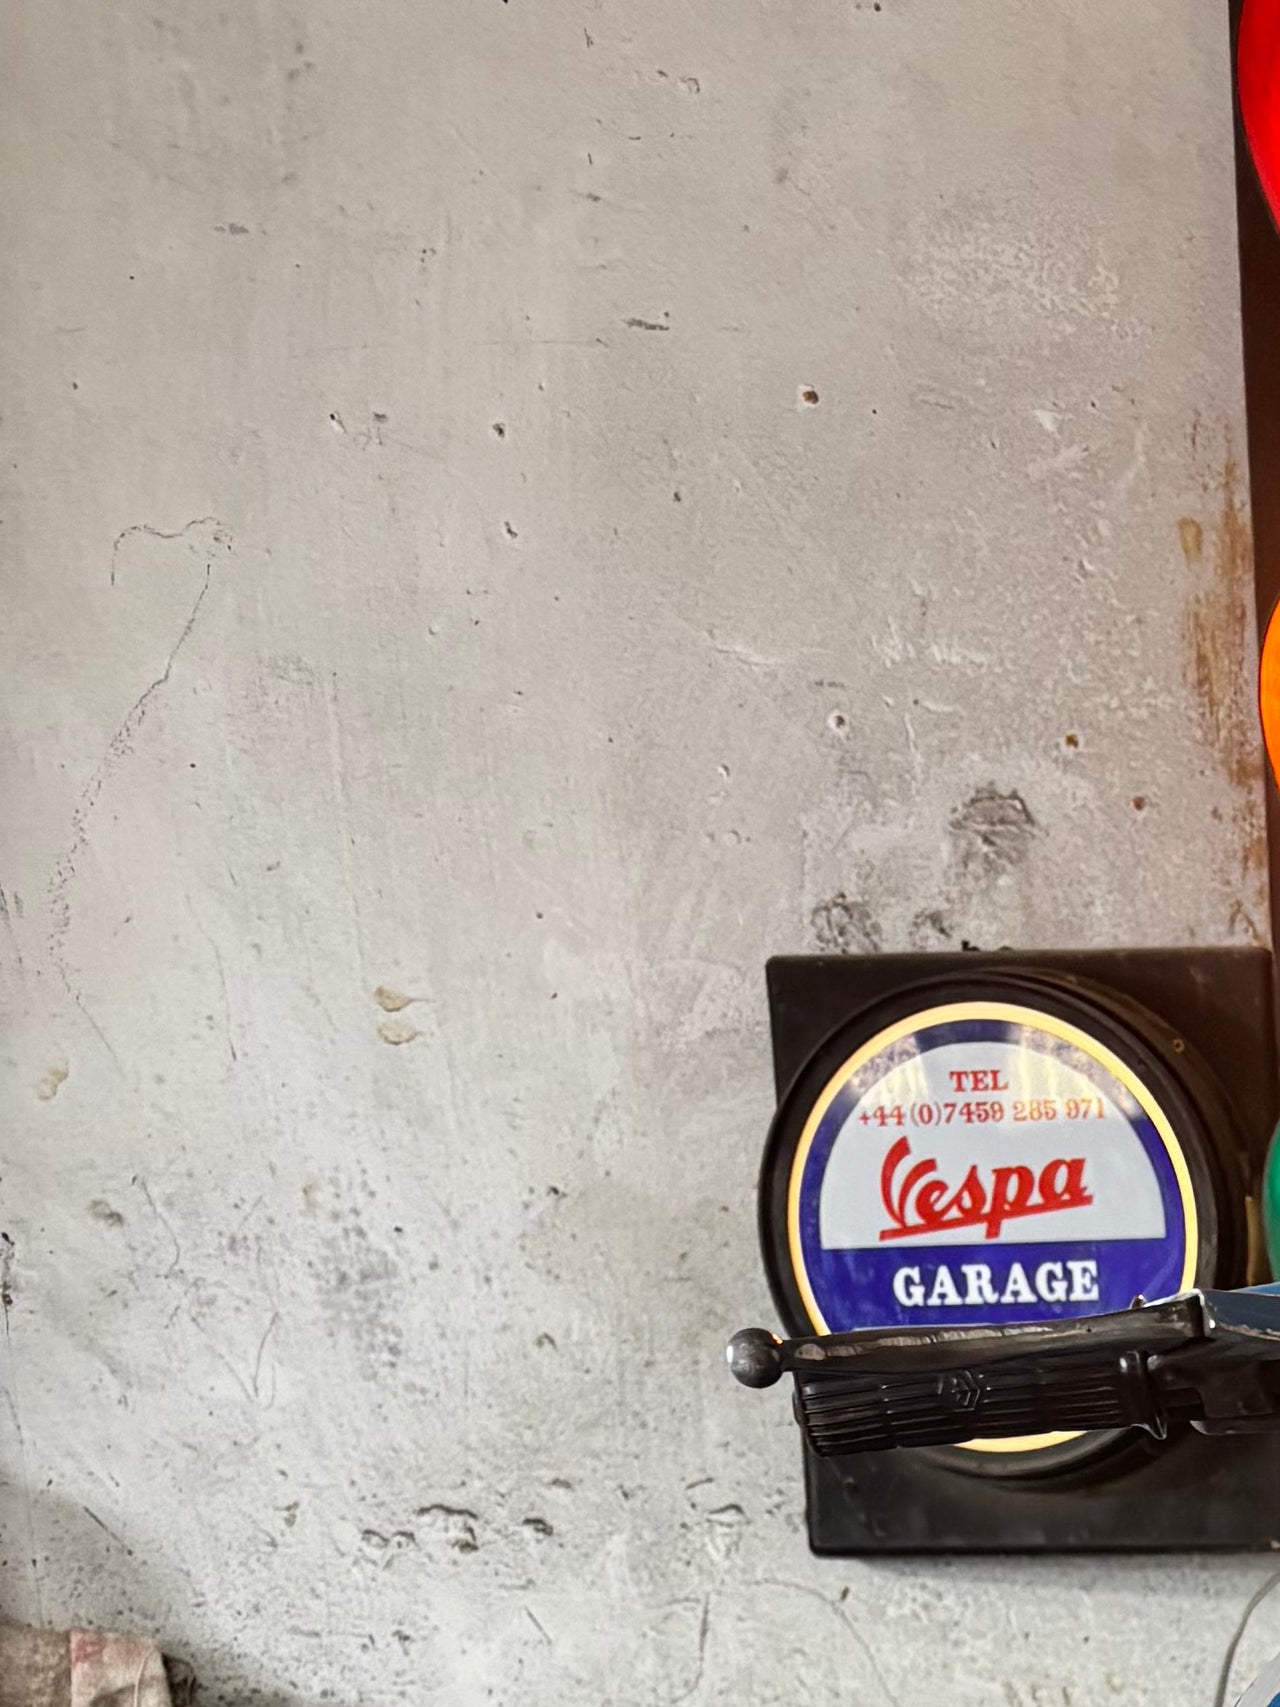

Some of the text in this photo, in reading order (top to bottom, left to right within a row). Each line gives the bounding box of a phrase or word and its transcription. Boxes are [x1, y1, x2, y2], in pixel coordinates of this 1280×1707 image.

[950, 1069, 1009, 1093] TEL
[1012, 1100, 1057, 1122] 285
[1065, 1096, 1106, 1119] 971
[879, 1135, 1094, 1241] Vespa
[893, 1259, 1101, 1307] GARAGE
